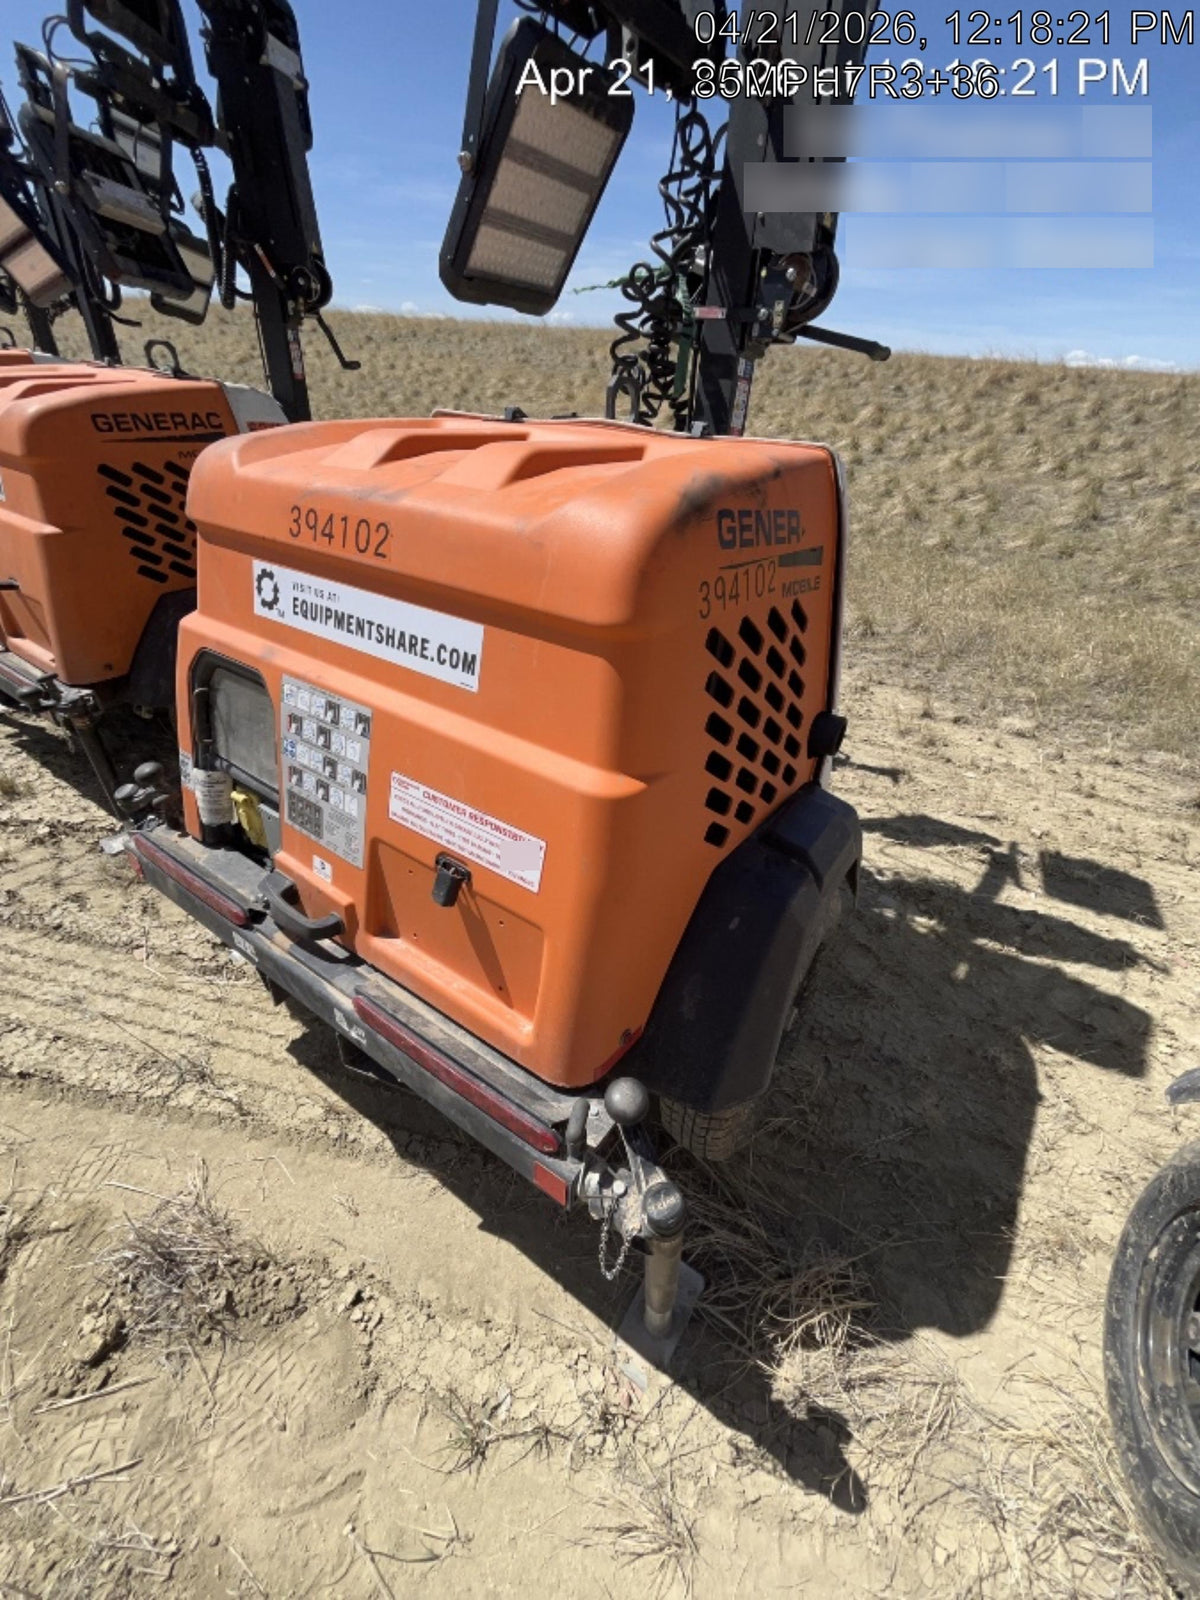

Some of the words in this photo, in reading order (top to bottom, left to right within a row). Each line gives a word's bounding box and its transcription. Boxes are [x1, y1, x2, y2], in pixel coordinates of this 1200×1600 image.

[91, 412, 223, 433] GENERAC
[289, 505, 390, 559] 394102
[717, 508, 806, 549] GENER
[699, 560, 776, 619] 394102
[292, 597, 477, 676] EQUIPMENTSHARE.COM
